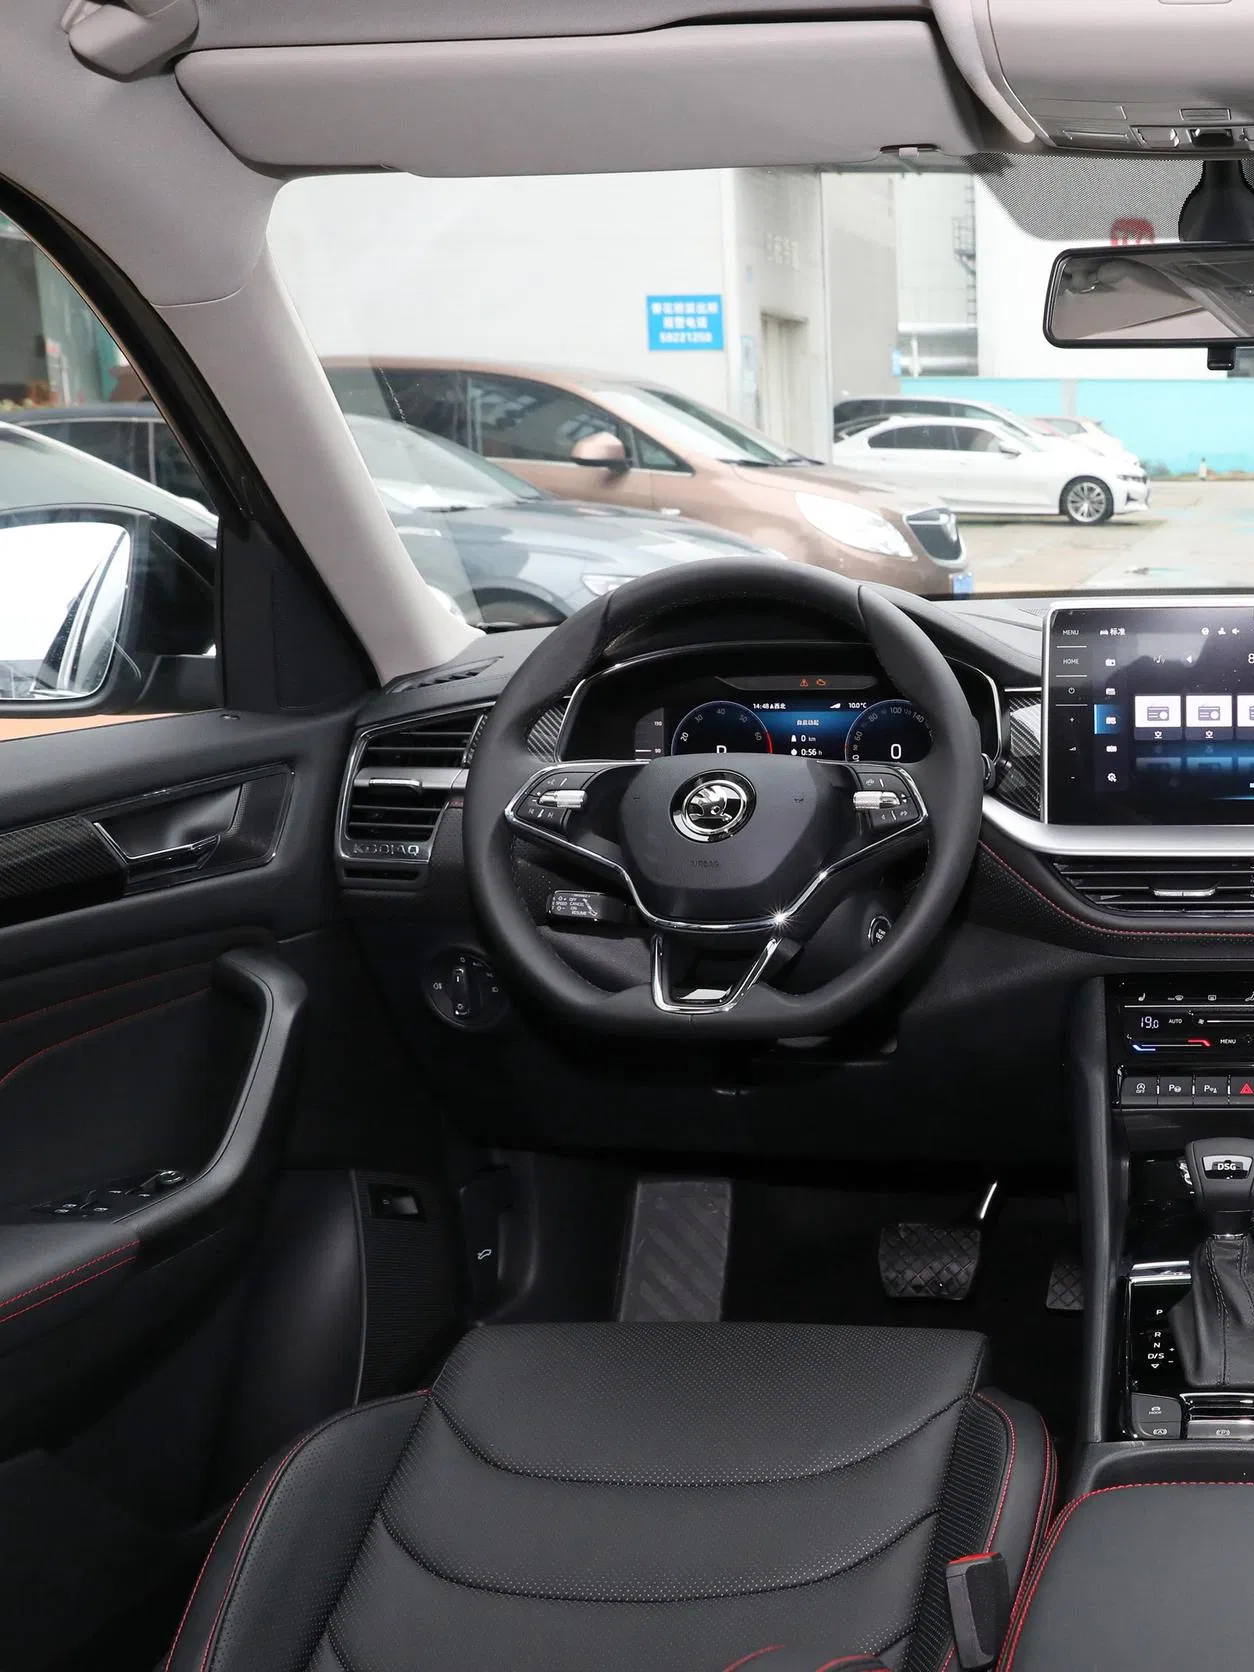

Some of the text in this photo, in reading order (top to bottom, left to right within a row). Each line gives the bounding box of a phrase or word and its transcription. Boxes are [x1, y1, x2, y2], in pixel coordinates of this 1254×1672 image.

[890, 706, 902, 714] 100
[680, 732, 689, 742] 20
[890, 743, 902, 760] 0
[1140, 1016, 1159, 1029] 19.0
[1217, 1163, 1237, 1171] DSG
[1147, 1352, 1165, 1360] D/S
